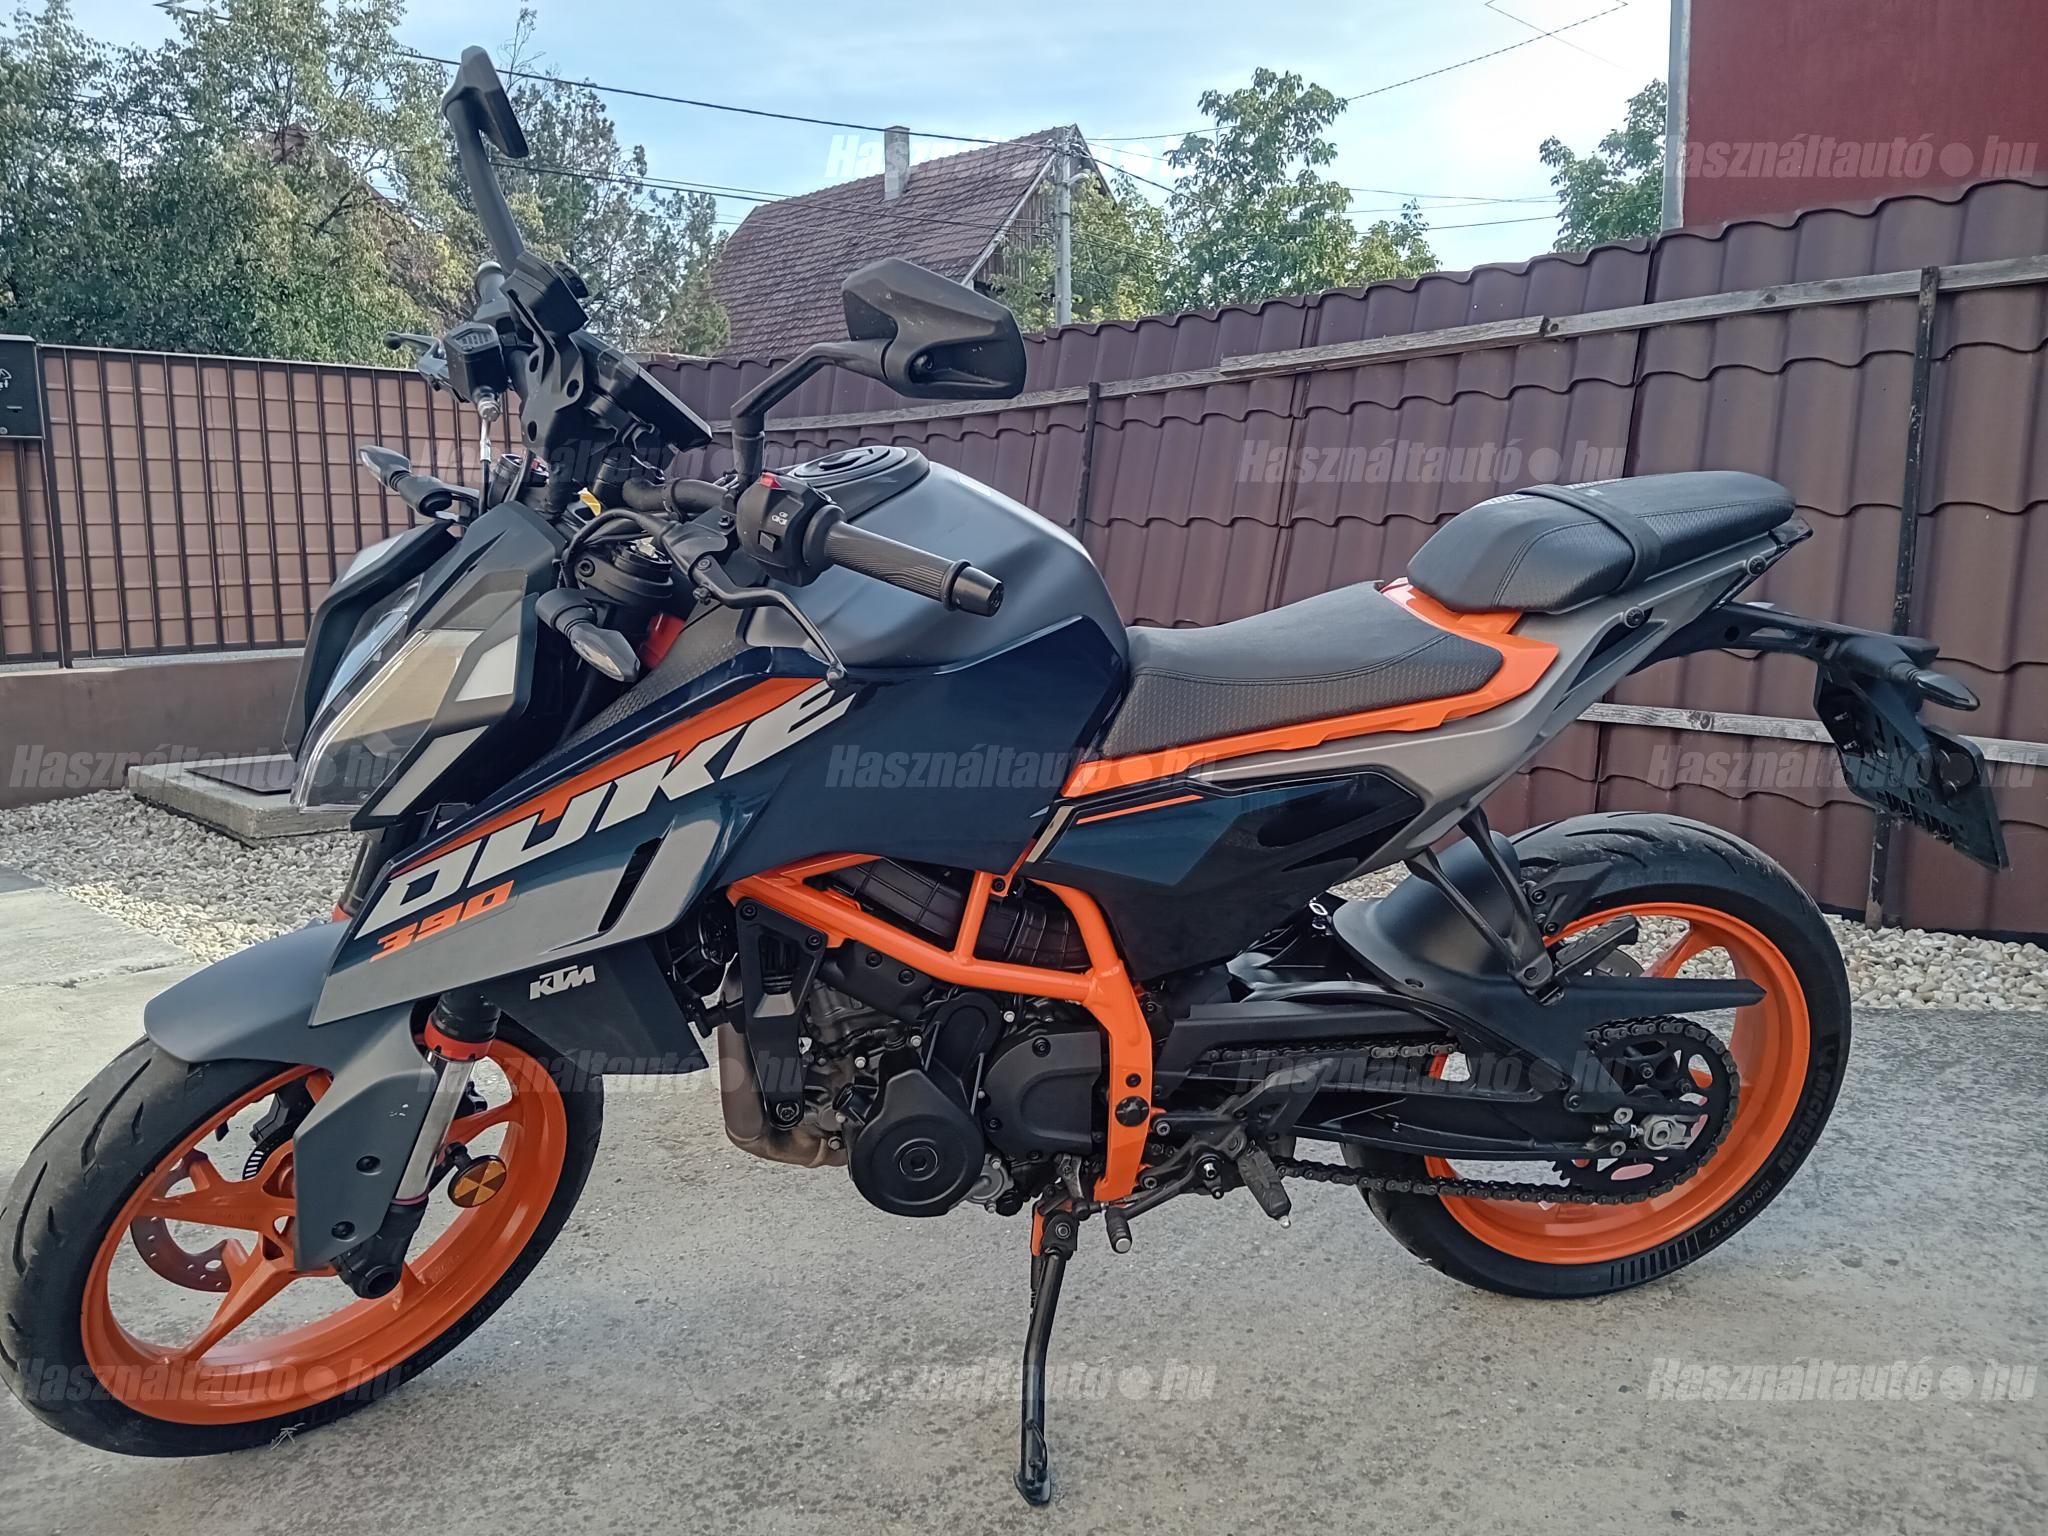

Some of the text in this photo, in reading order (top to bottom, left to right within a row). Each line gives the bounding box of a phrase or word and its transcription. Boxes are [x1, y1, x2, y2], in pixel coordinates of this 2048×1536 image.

[355, 680, 855, 940] DUKE
[370, 880, 514, 962] 390
[529, 964, 596, 1000] KTM
[1777, 1070, 1835, 1172] MICHELIN
